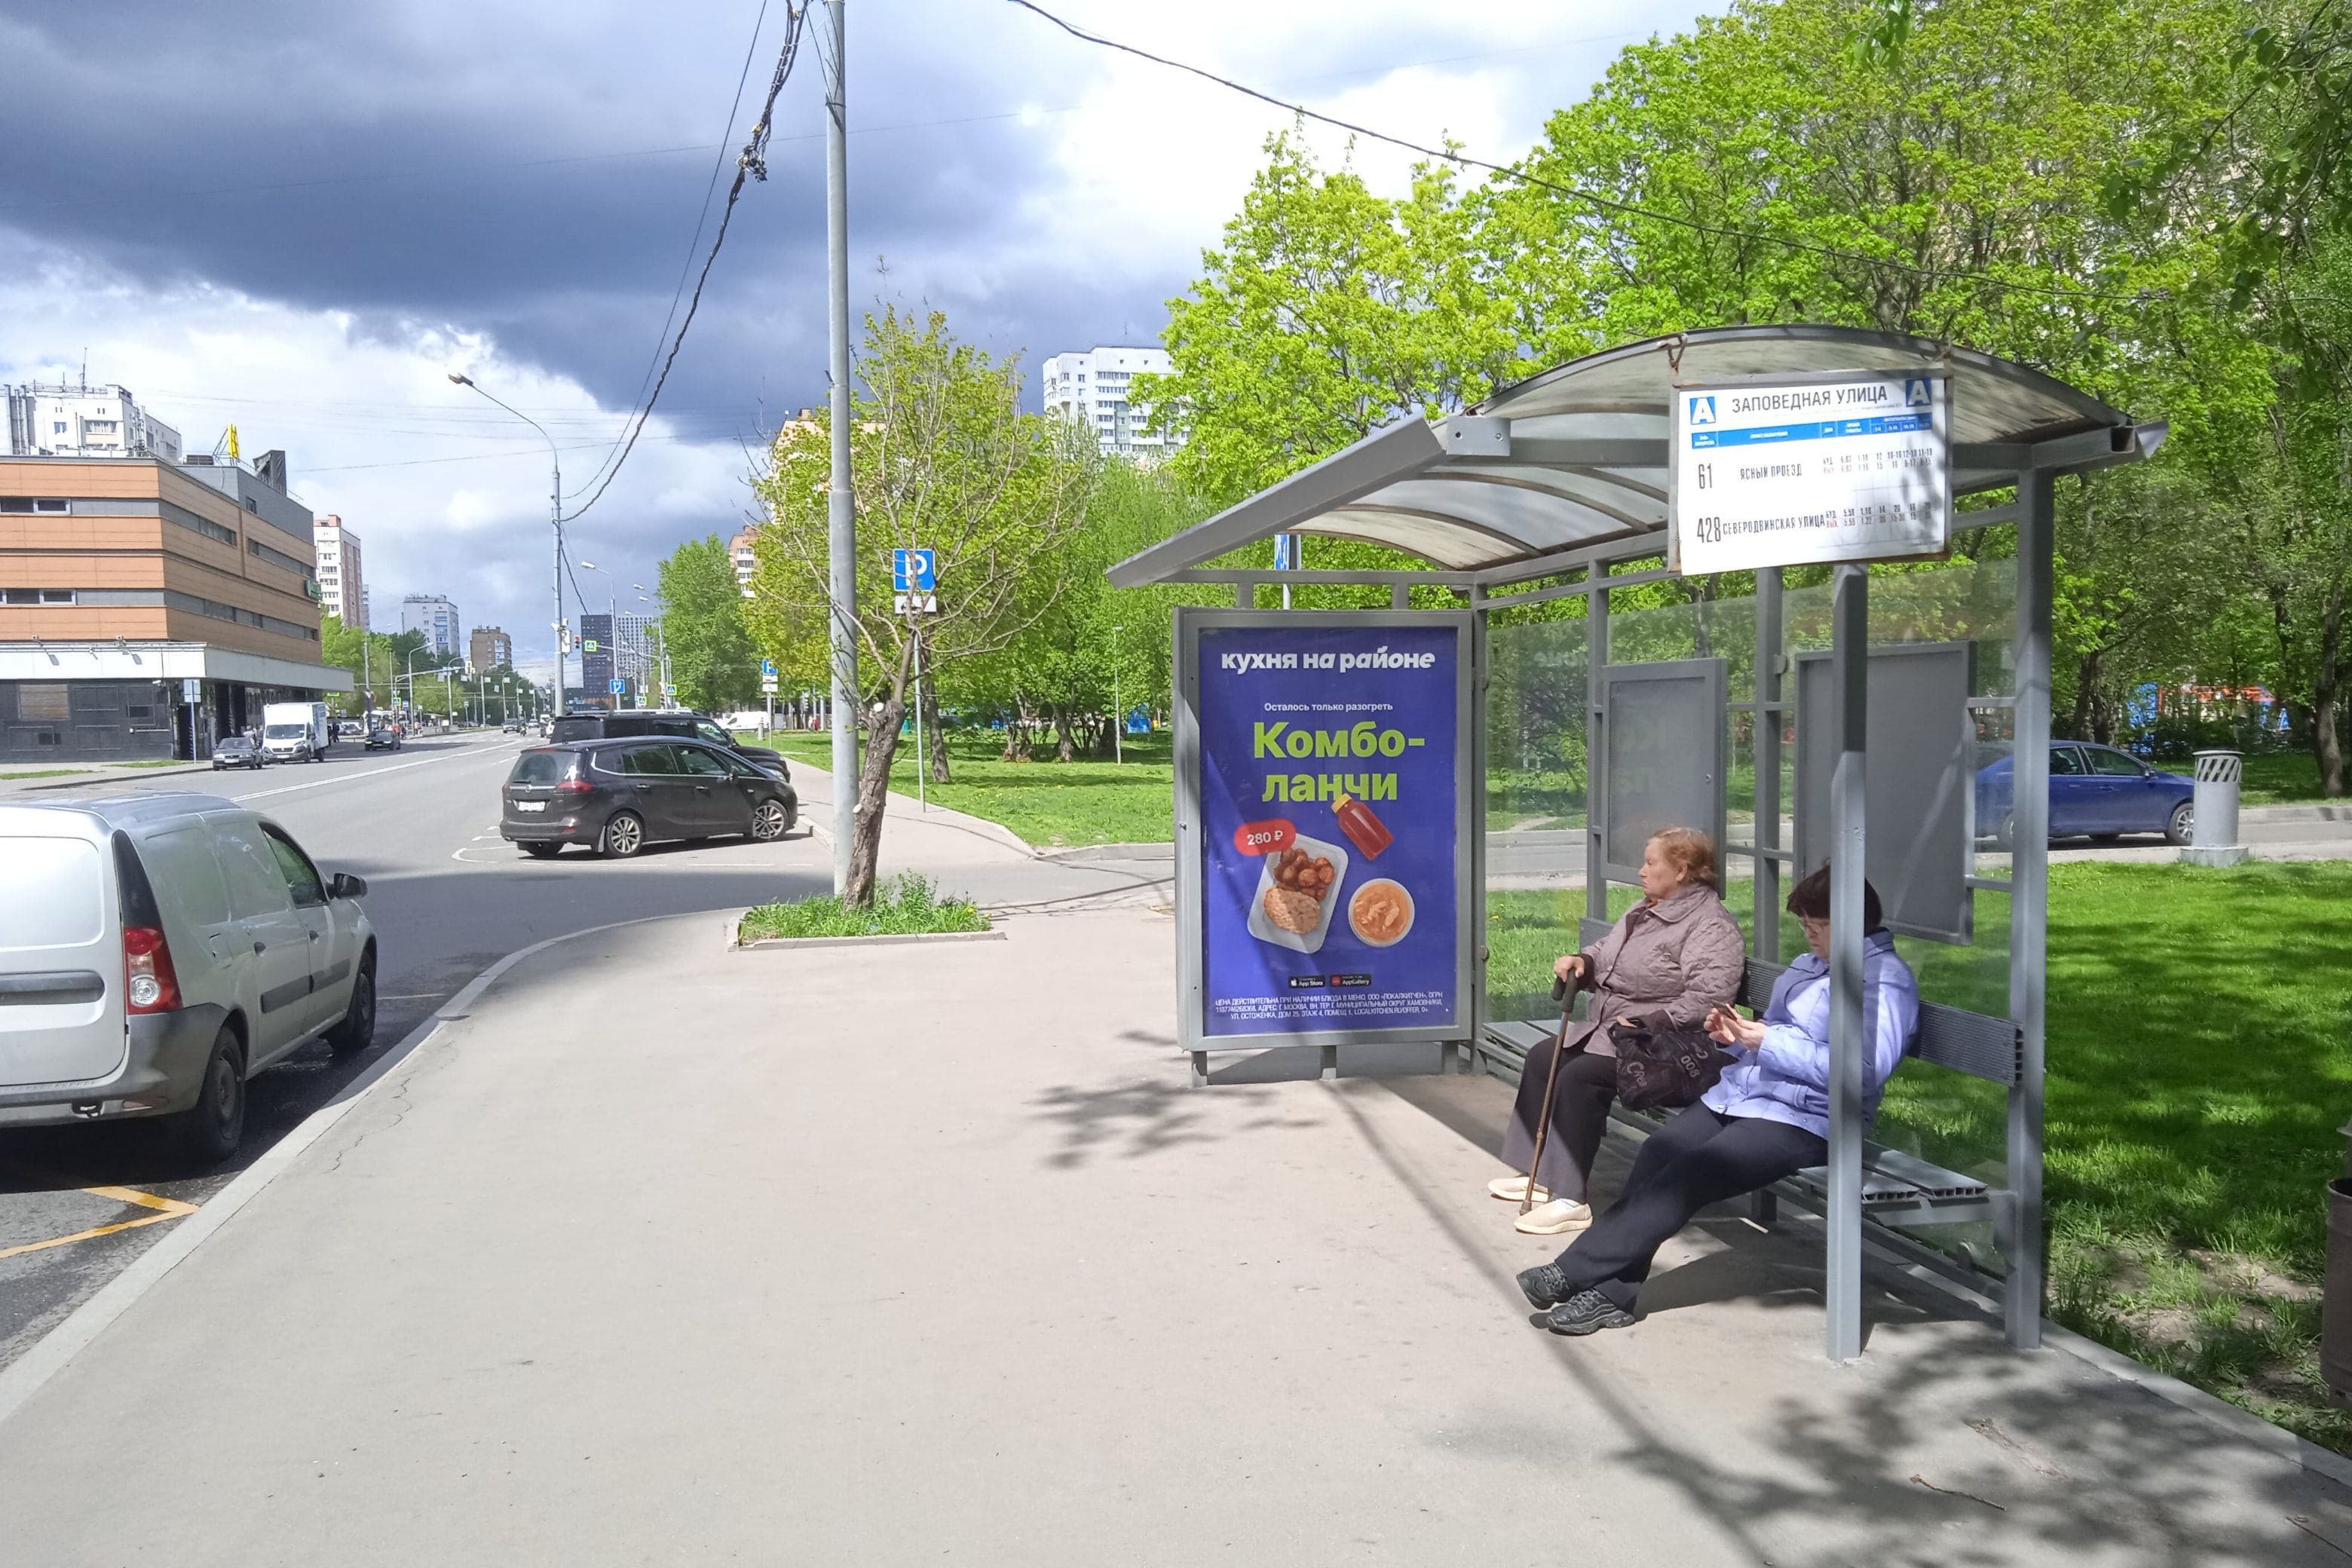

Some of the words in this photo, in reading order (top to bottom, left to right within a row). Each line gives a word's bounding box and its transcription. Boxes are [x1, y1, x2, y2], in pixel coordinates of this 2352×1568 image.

[1732, 390, 1830, 413] ЗАПОВЕДНАЯ
[1837, 385, 1888, 404] УЛИЦА
[1698, 463, 1713, 489] 61
[1740, 467, 1769, 480] ЯСНЫЙ
[1771, 464, 1802, 477] ПРОЕЗД
[1697, 516, 1721, 543] 428
[1723, 517, 1796, 535] СЕВЕРОДВИНСКАЯ
[1798, 514, 1825, 528] УЛИЦА
[1222, 653, 1297, 675] кухня
[1303, 653, 1336, 669] на
[1340, 645, 1435, 673] районе
[1264, 702, 1309, 712] Осталось
[1312, 703, 1344, 712] только
[1346, 702, 1393, 712] разогреть
[1254, 721, 1425, 759] Комбо-
[1262, 773, 1397, 802] ланчи
[1247, 831, 1272, 845] 280
[1232, 997, 1279, 1006] ДЕЙСТВИТЕЛЬНА
